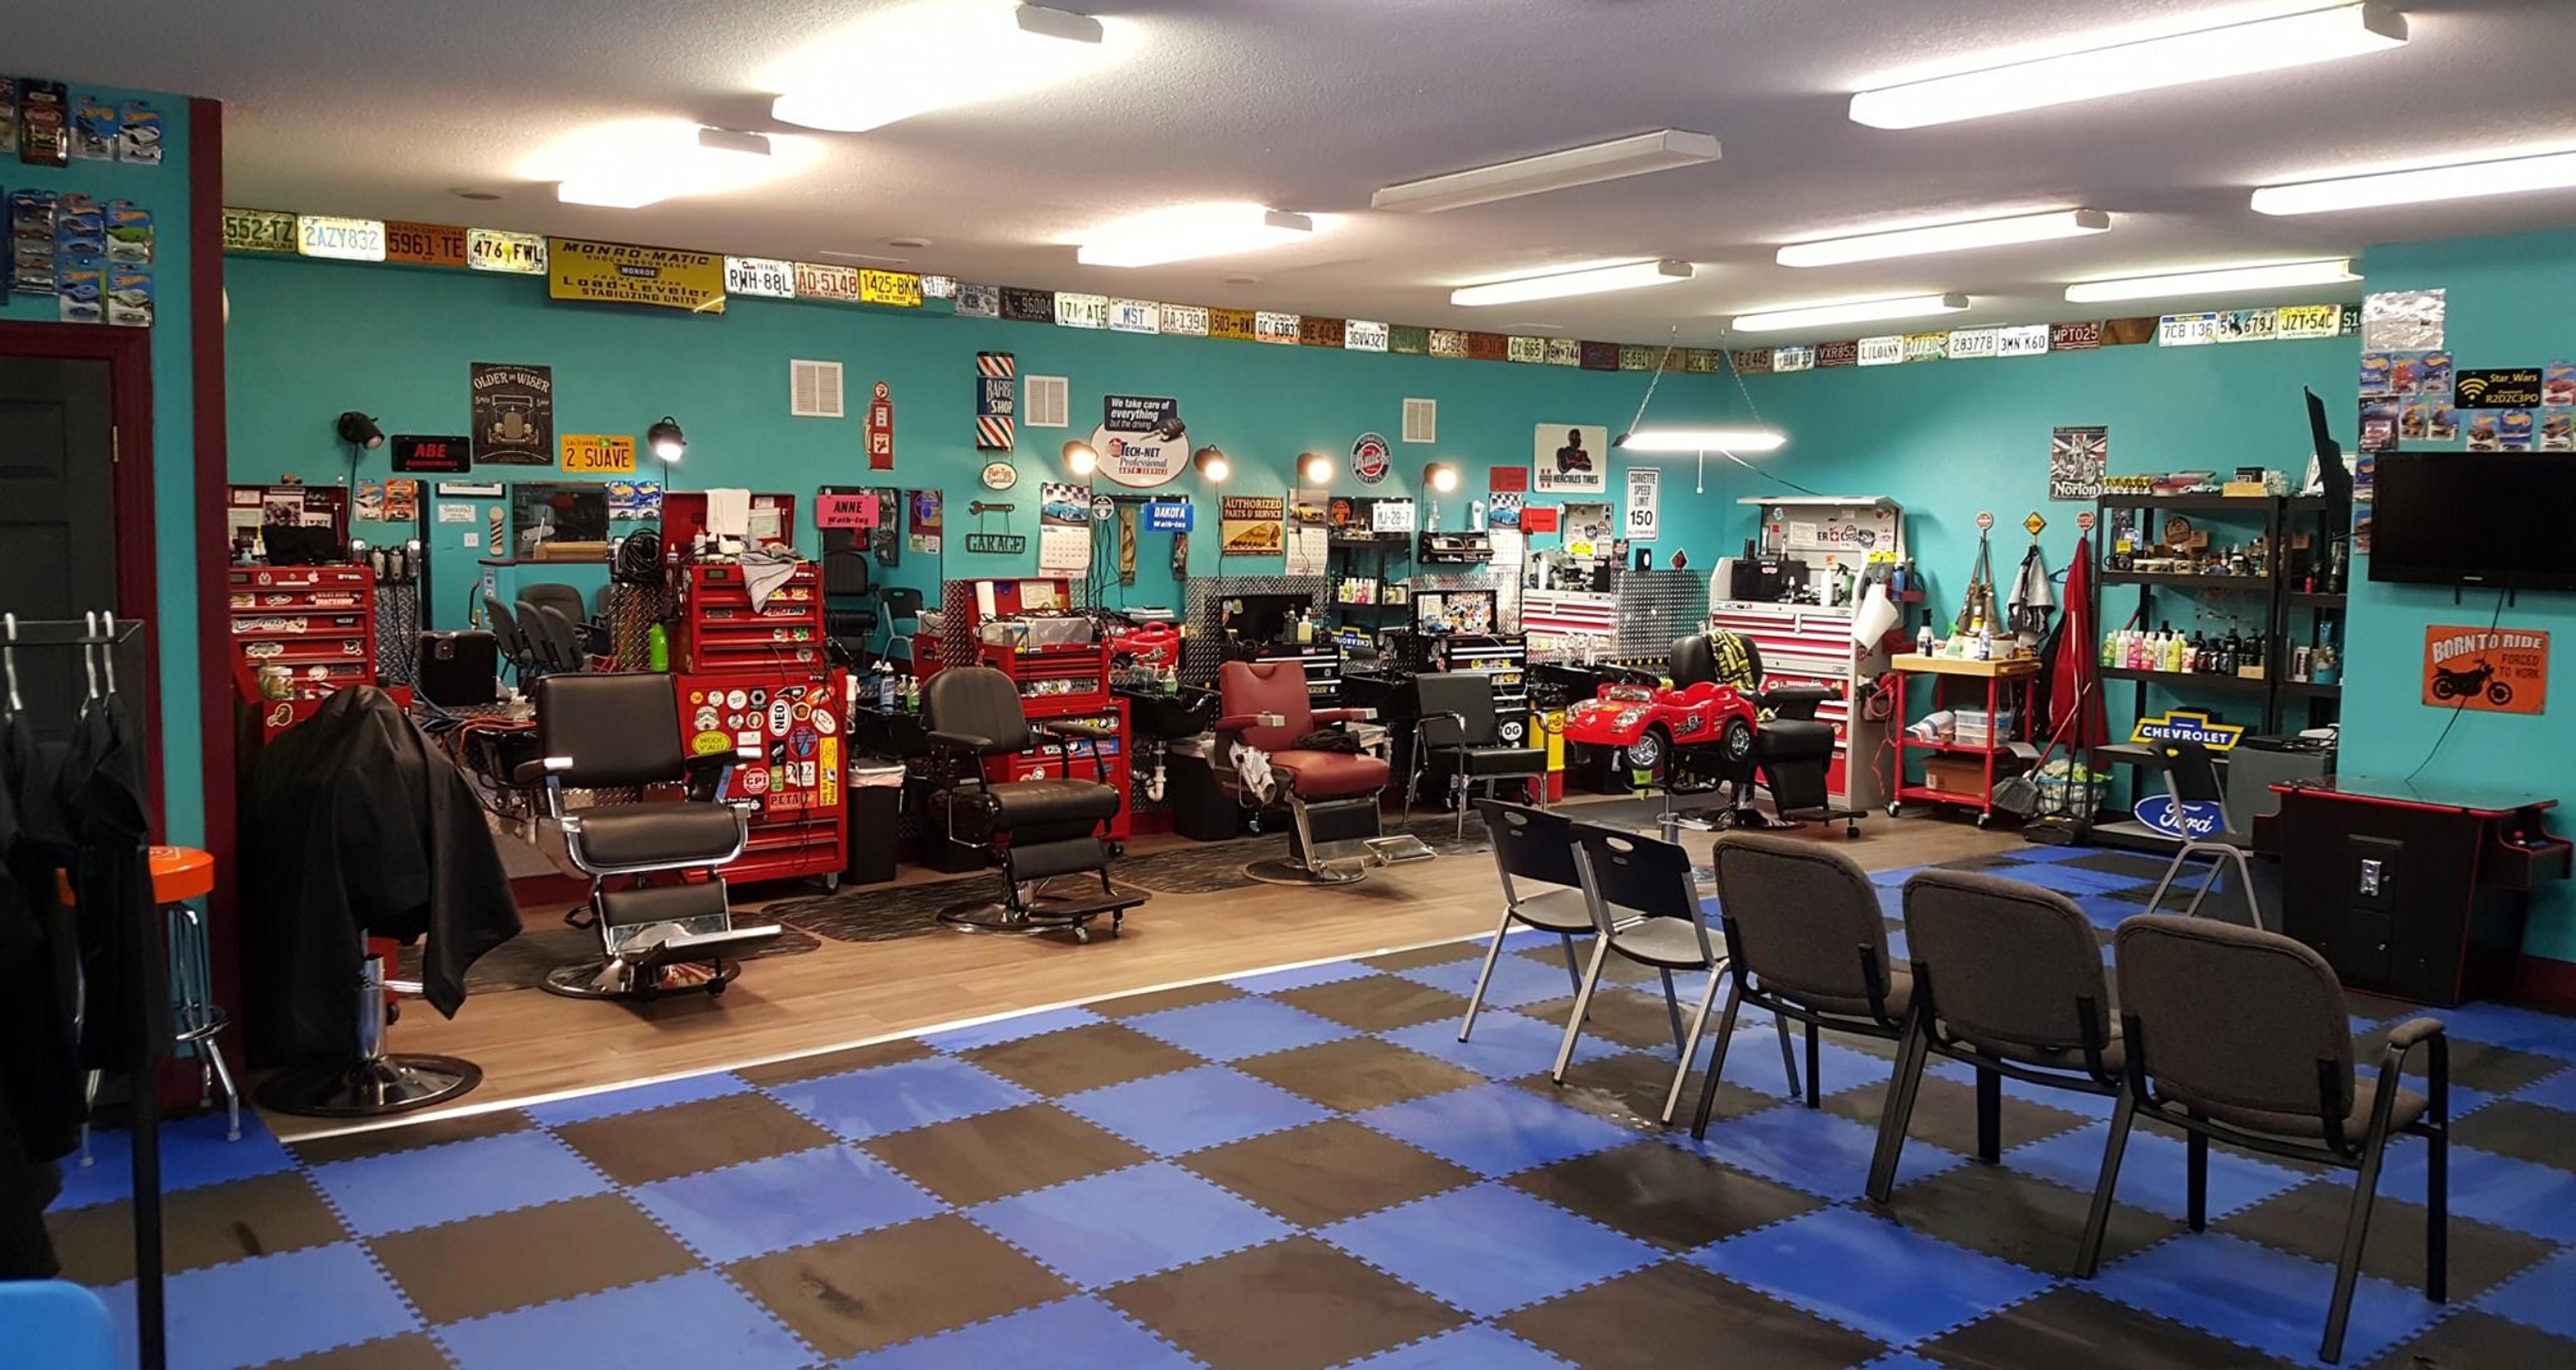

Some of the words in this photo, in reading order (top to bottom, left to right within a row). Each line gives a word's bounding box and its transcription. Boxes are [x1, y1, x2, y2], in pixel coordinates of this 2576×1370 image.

[305, 226, 379, 250] 2AZY832
[473, 241, 503, 258] 476
[513, 244, 544, 262] FWL
[627, 259, 689, 270] ABSORBERS
[621, 267, 656, 277] MONROE
[730, 270, 791, 293] RWH-88L
[864, 273, 920, 296] 1425-BKM
[581, 288, 660, 301] STABILIZING
[664, 295, 698, 306] UNITS
[1123, 307, 1145, 325] MST
[2163, 325, 2186, 339] 7CB
[2191, 322, 2213, 337] 136
[2245, 316, 2275, 332] 679J
[2025, 335, 2045, 349] K60
[2053, 327, 2099, 343] WPT025
[1820, 345, 1857, 359] VXR852
[473, 372, 508, 389] OLDER
[517, 372, 550, 393] WISER
[1111, 398, 1123, 407] We
[1125, 399, 1141, 409] take
[1144, 400, 1160, 410] care
[1161, 401, 1170, 410] of
[2485, 393, 2539, 404] R2D2C3PO
[991, 399, 1013, 414] SHOP
[1110, 408, 1159, 422] everything
[1109, 418, 1120, 428] but
[1121, 419, 1131, 429] the
[1132, 421, 1152, 430] driving
[414, 443, 447, 458] ABE
[567, 448, 575, 466] 2
[585, 448, 630, 467] SUAVE
[1119, 456, 1168, 468] Professional
[1552, 474, 1582, 484] HERCULES
[1583, 474, 1599, 484] TIRES
[1630, 473, 1656, 484] CORVETTE
[1634, 484, 1651, 496] SPEED
[2050, 481, 2101, 497] Norton
[834, 501, 863, 514] ANNE
[1224, 498, 1282, 509] AUTHORIZED
[1634, 496, 1649, 507] LIMIT
[1153, 507, 1186, 519] DAKOTA
[1224, 508, 1247, 519] PARTS
[1254, 509, 1282, 519] SERVICE
[1630, 510, 1653, 526] 150
[969, 536, 1024, 551] GARAGE
[2432, 635, 2476, 664] BORN
[2476, 634, 2499, 650] TO
[2502, 634, 2543, 649] RIDE
[2500, 654, 2539, 667] FORCED
[2500, 667, 2512, 677] TO
[2515, 667, 2540, 679] WORK
[775, 704, 785, 729] NEO
[1504, 725, 1520, 735] OG
[2142, 726, 2228, 744] CHEVROLET
[2159, 802, 2215, 833] Frd
